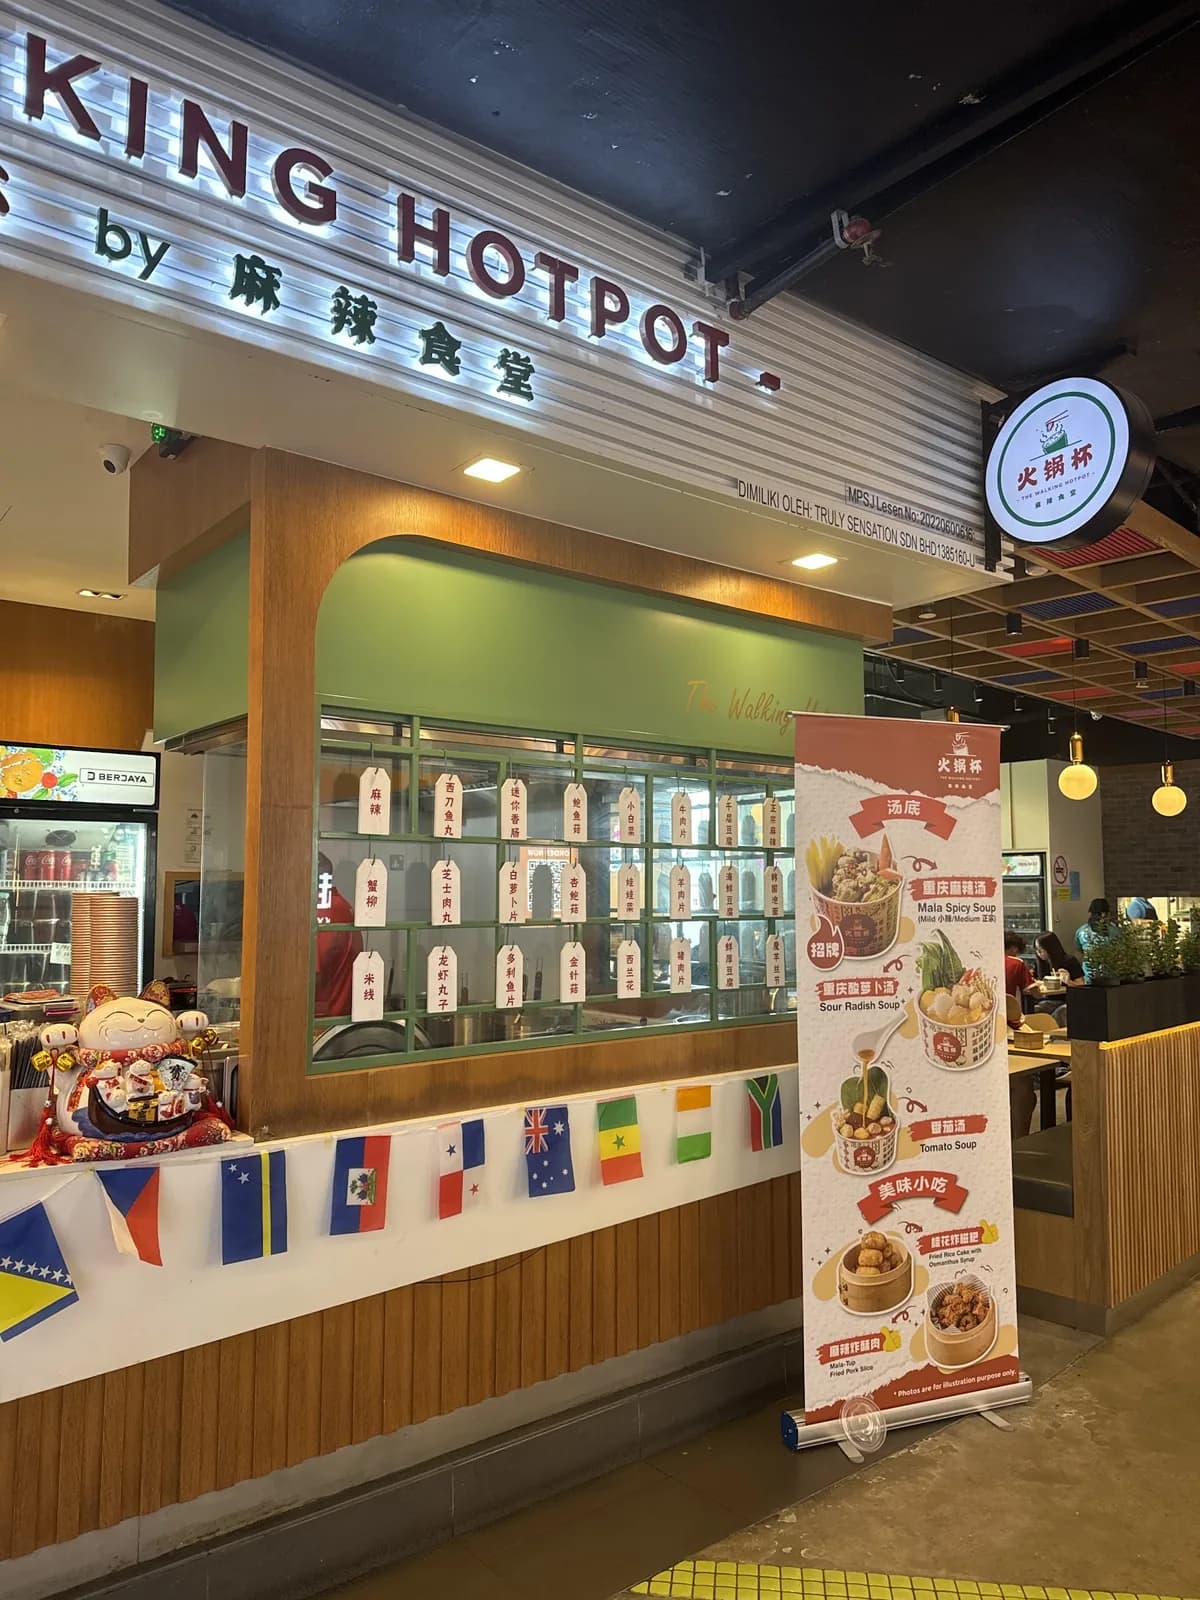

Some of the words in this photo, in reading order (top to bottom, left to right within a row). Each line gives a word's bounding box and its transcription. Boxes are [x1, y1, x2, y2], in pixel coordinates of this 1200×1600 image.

[95, 207, 170, 279] by
[396, 192, 730, 383] HOTPOT
[229, 252, 535, 402] 麻辣食堂
[1017, 443, 1093, 491] 火锅杯
[1034, 483, 1063, 496] WALKING
[1064, 472, 1091, 486] HOTPOT
[738, 480, 780, 509] DIMILIKI
[782, 494, 812, 519] OLEH:
[814, 504, 845, 529] TRULY
[847, 515, 898, 544] SENSATION
[899, 531, 918, 550] SDN
[848, 486, 875, 509] MPSJ
[876, 494, 904, 520] Lesen
[727, 687, 792, 737] Walking
[937, 756, 983, 775] 火锅杯
[370, 788, 382, 816] 麻辣
[444, 782, 455, 836] 西刀鱼丸
[510, 786, 520, 839] 迷你香肠
[627, 801, 635, 836] 小白菜
[887, 799, 921, 816] 汤底
[679, 805, 687, 839] 牛肉片
[366, 879, 378, 908] 蟹柳
[441, 868, 453, 923] 芝士肉丸
[509, 869, 518, 922] 白萝卜片
[569, 877, 579, 914] 杏鲍菇
[625, 877, 634, 912] 娃娃菜
[677, 878, 686, 913] 羊肉片
[922, 880, 987, 896] 重庆麻辣汤
[918, 902, 943, 913] Mala
[945, 902, 971, 915] Spicy
[973, 902, 996, 914] Soup
[810, 942, 840, 958] 招牌
[363, 972, 375, 1001] 米线
[437, 954, 449, 1011] 龙虾丸子
[505, 952, 516, 1007] 多利鱼片
[569, 956, 579, 994] 金针菇
[626, 954, 635, 991] 西兰花
[822, 981, 895, 996] 重庆酸萝卜汤
[819, 1002, 842, 1012] Sour
[845, 1001, 876, 1011] Radish
[878, 1000, 900, 1010] Soup
[931, 1119, 966, 1135] 番茄汤
[919, 1142, 953, 1153] Tomato
[954, 1140, 977, 1151] Soup
[878, 1176, 949, 1201] 美味小吃
[897, 1388, 920, 1397] Photos
[921, 1385, 932, 1393] are
[932, 1383, 942, 1391] for
[942, 1376, 976, 1388] illustration
[976, 1372, 1002, 1384] purpose
[1002, 1368, 1017, 1379] only.
